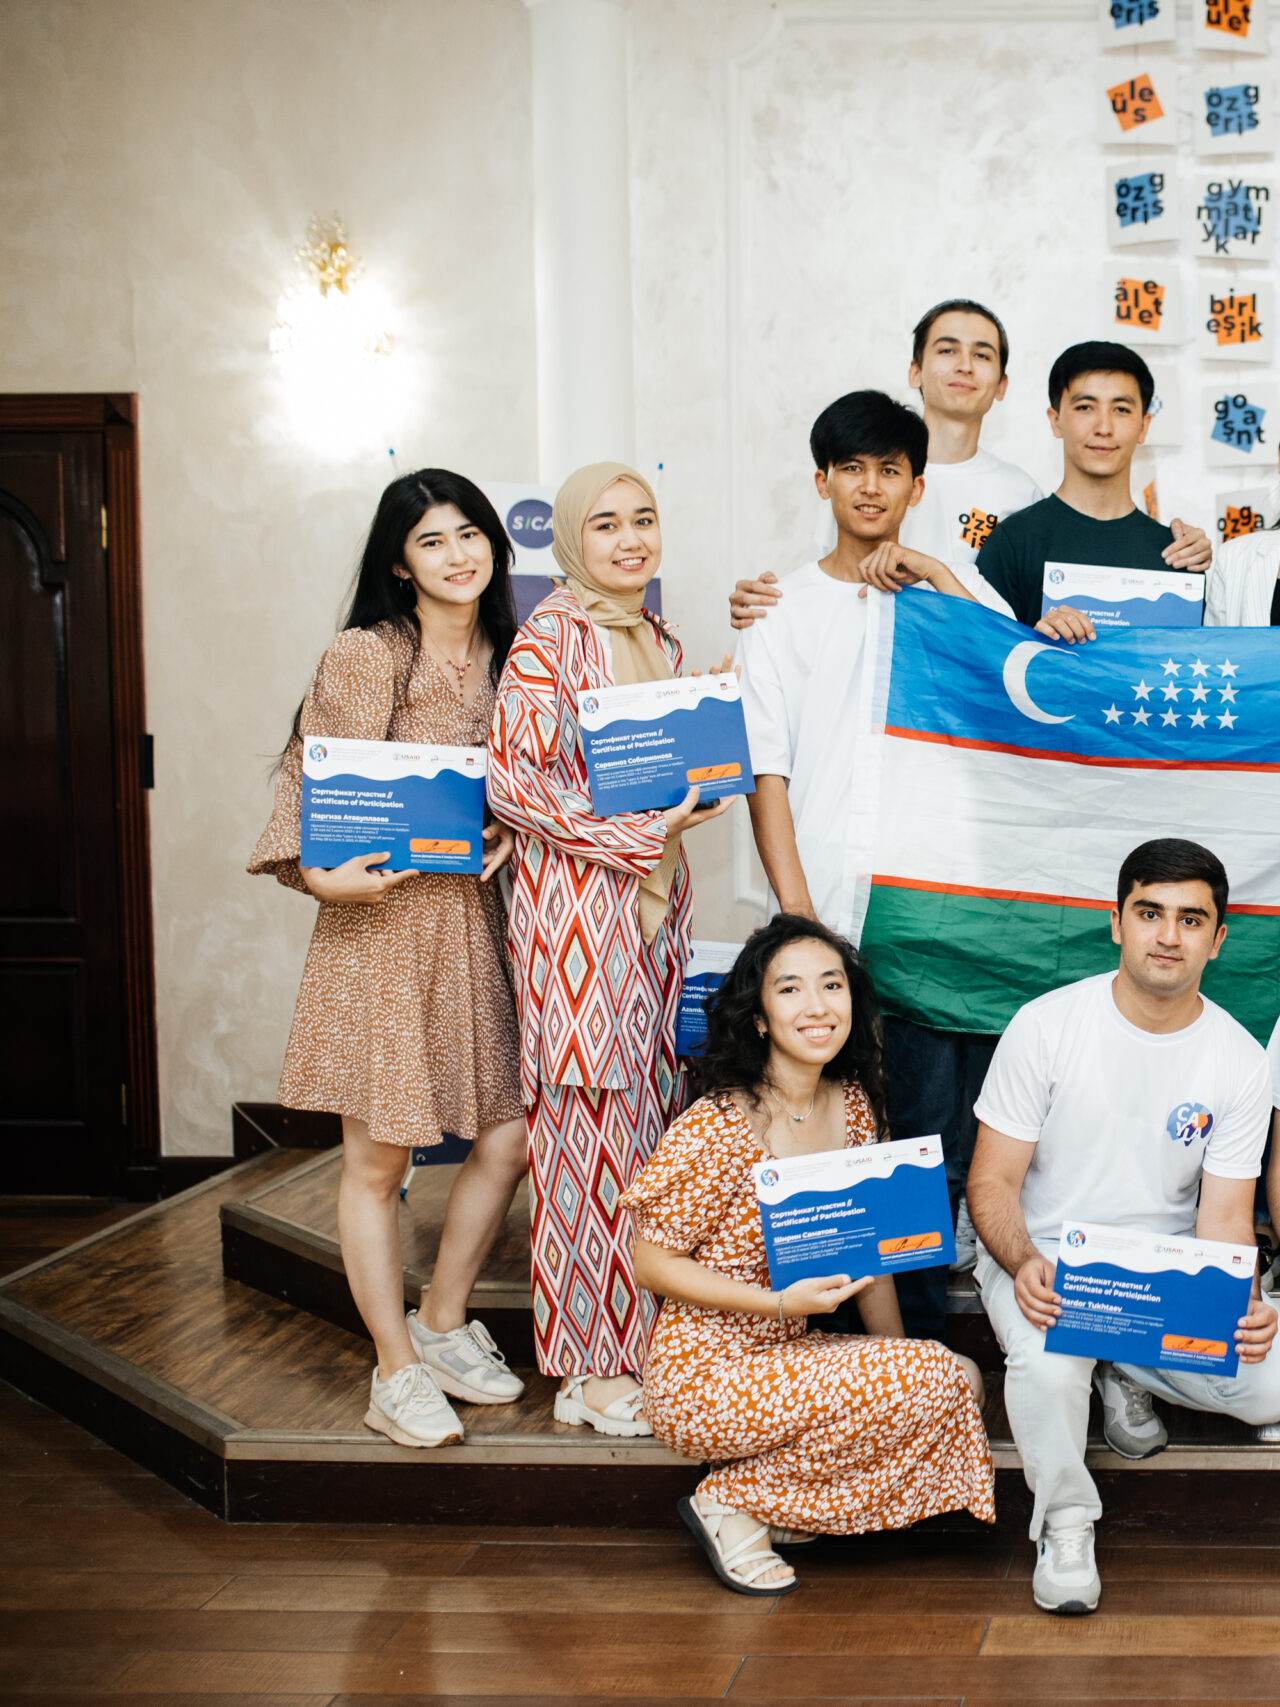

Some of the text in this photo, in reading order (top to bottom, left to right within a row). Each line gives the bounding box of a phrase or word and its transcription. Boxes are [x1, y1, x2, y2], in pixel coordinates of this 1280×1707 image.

[1091, 617, 1130, 626] Participation
[590, 731, 657, 746] Сертификат участия
[592, 744, 626, 754] Certificate
[634, 737, 675, 748] Participation
[311, 788, 356, 797] Сертификат
[311, 797, 349, 806] Certificate
[359, 799, 404, 808] Participation
[769, 1201, 846, 1219] Сертификат участия
[771, 1207, 866, 1228] Certificate of Participation
[1064, 1273, 1143, 1290] Сертификат участия
[1063, 1282, 1161, 1303] Certificate of Participation
